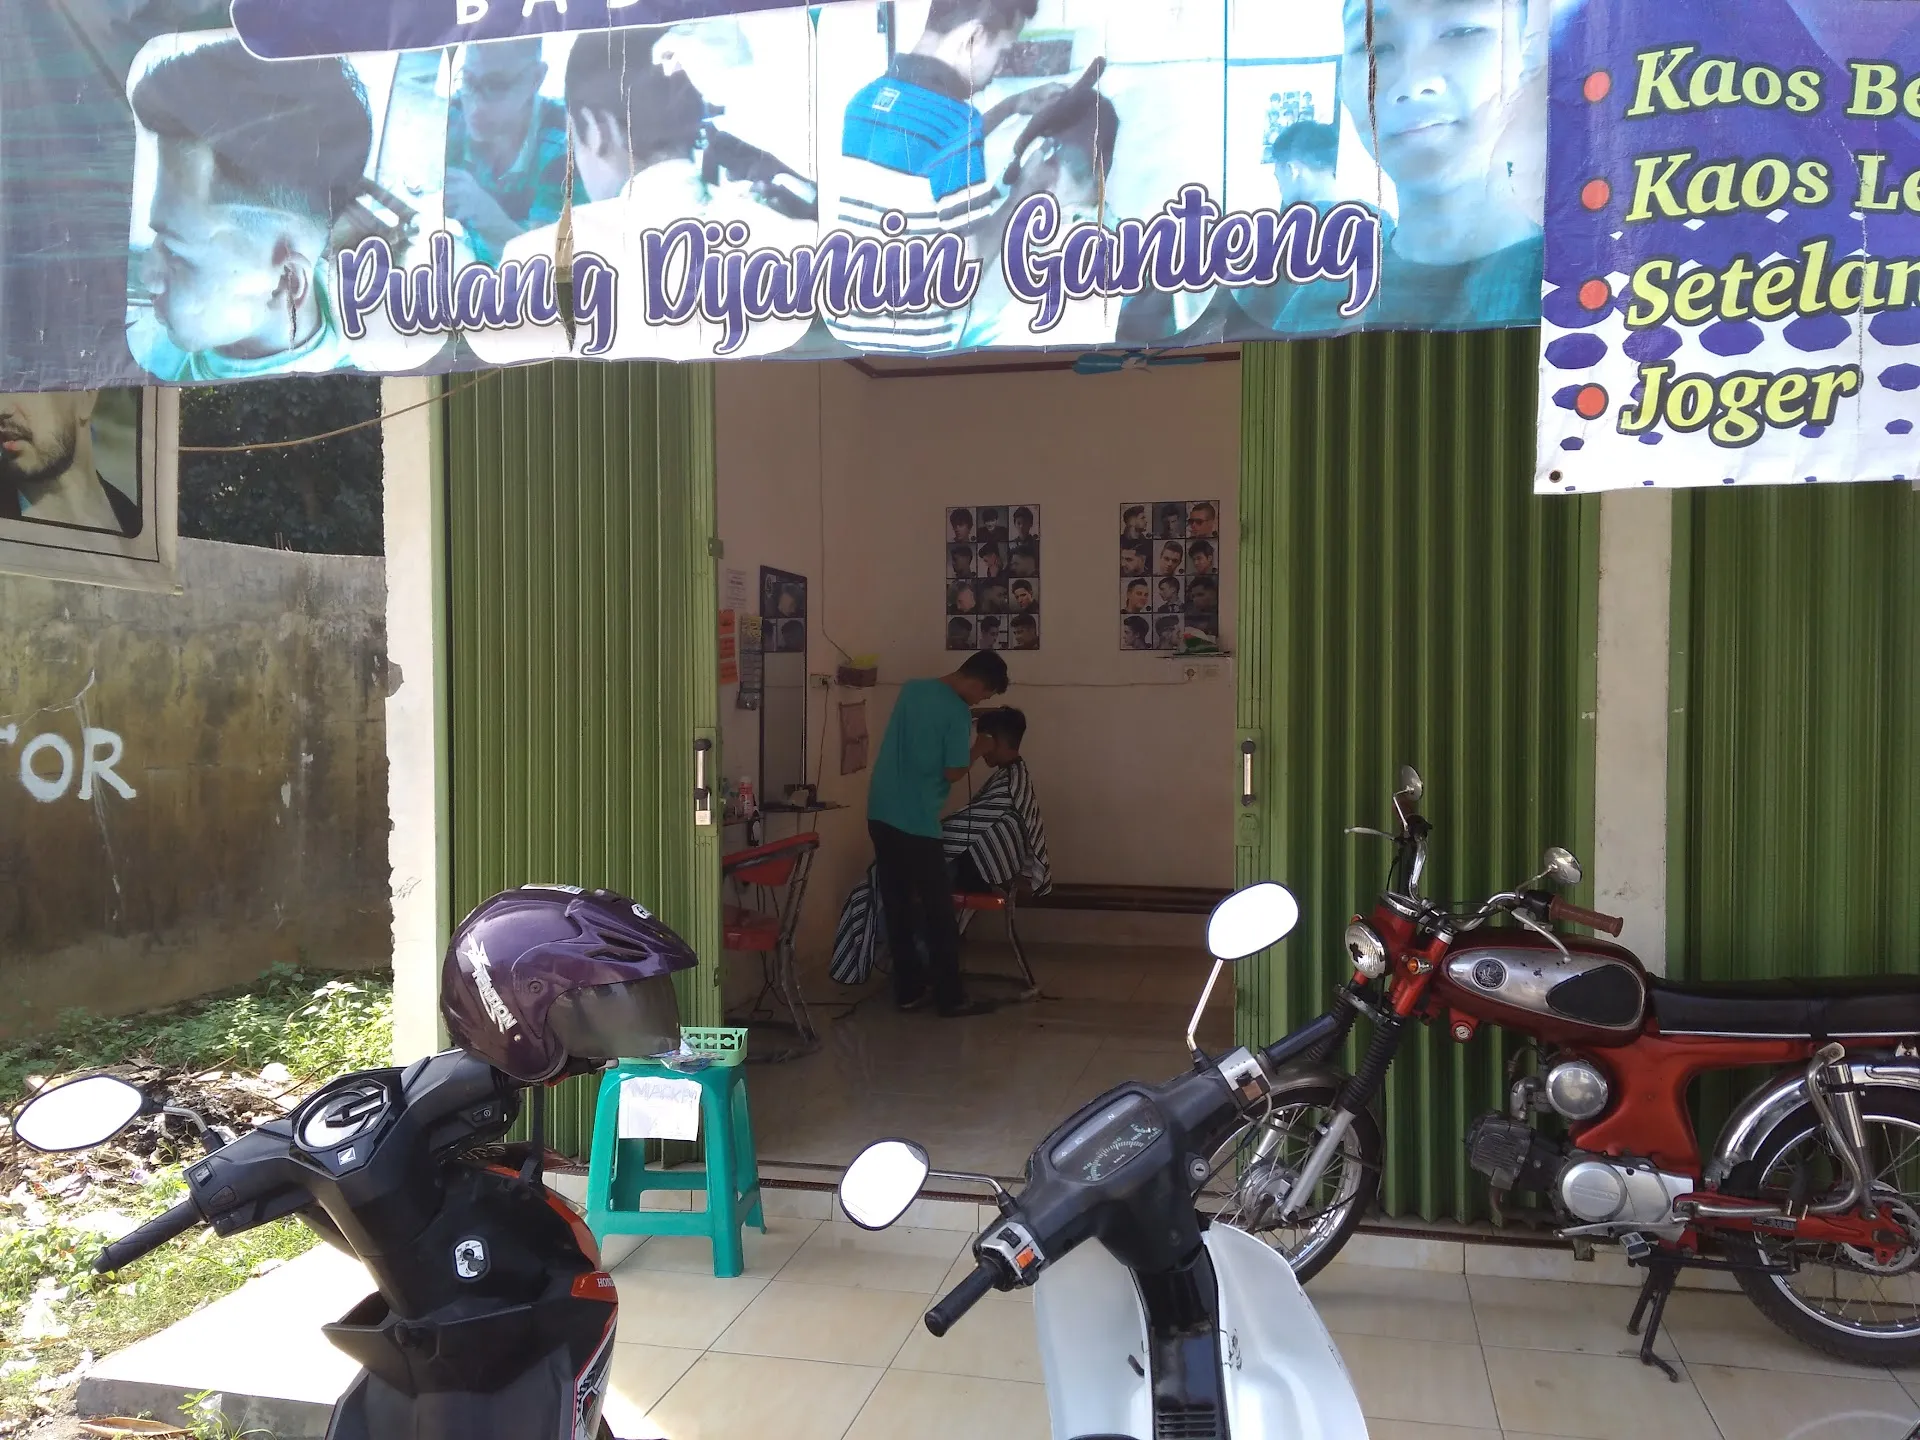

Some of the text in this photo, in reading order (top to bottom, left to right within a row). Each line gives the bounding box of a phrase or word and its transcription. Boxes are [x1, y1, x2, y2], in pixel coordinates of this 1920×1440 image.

[1626, 45, 1821, 117] Kaos
[1625, 152, 1830, 222] Kaos
[339, 184, 1382, 354] Pulang Dijamin Ganteng
[1624, 239, 1920, 328] Setelan
[1618, 366, 1859, 443] Joger
[596, 1277, 614, 1288] HON
